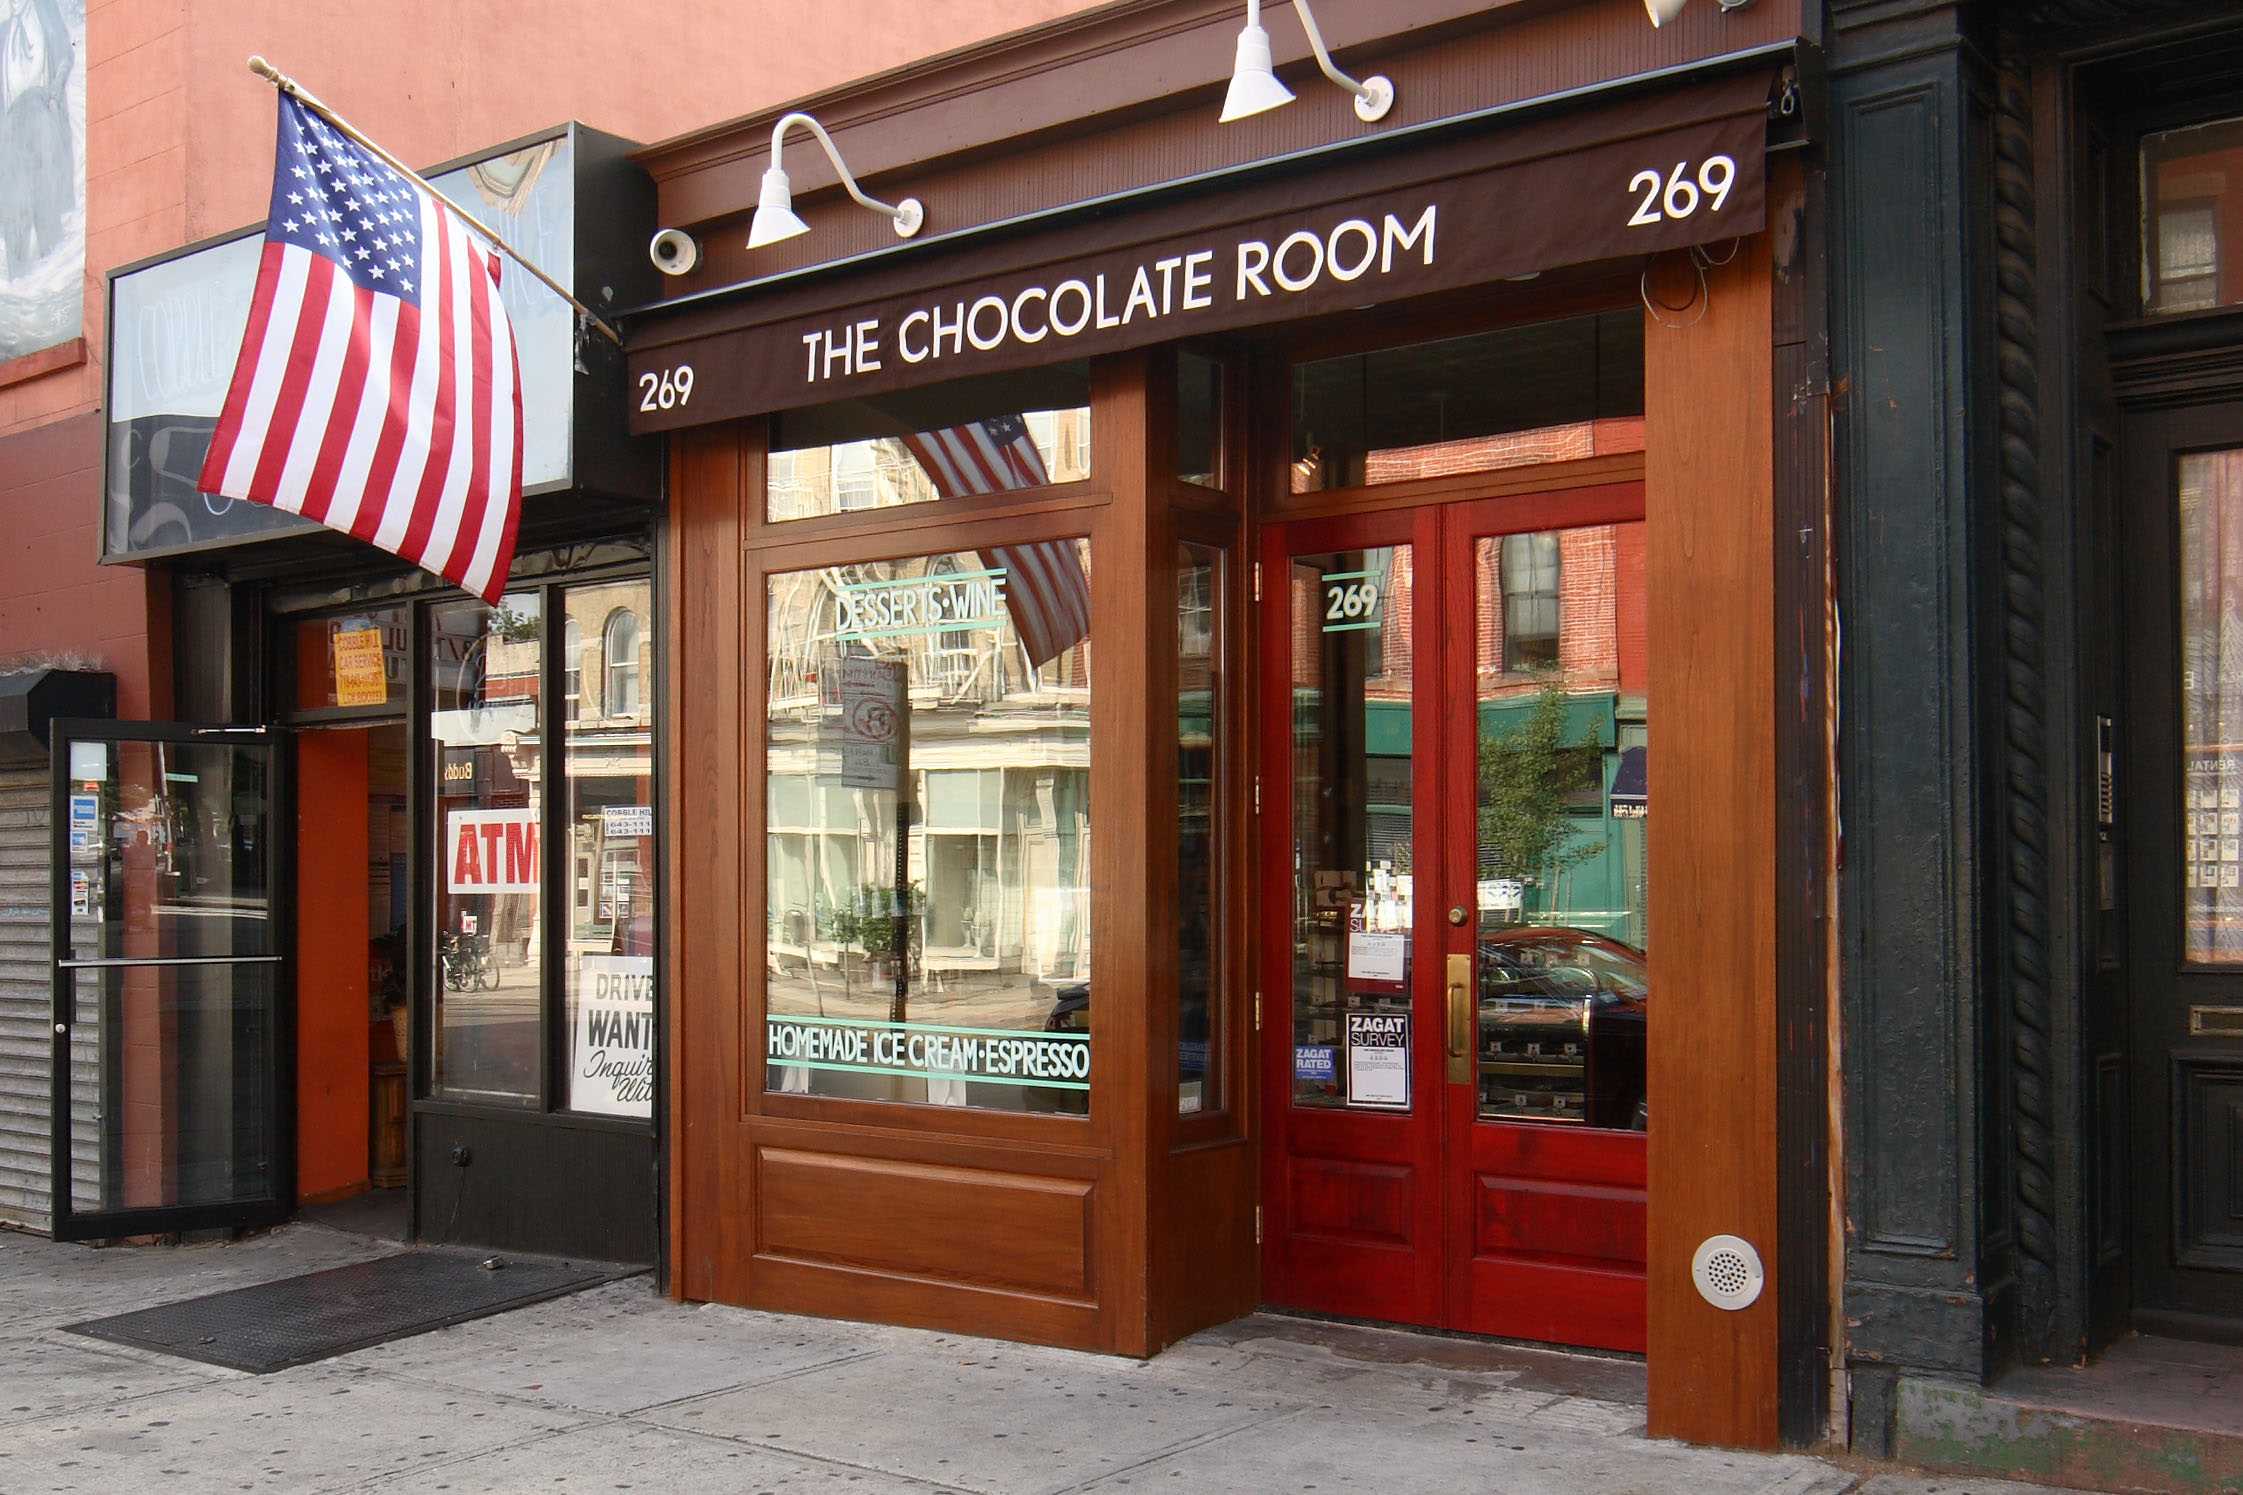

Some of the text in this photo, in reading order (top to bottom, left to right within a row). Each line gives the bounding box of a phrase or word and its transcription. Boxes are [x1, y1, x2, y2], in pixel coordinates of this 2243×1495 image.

[1626, 155, 1736, 227] 269
[802, 204, 1438, 383] THE CHOCOLATE ROOM
[638, 365, 695, 413] 269
[1326, 583, 1378, 620] 269
[453, 822, 541, 884] ATM
[1350, 1017, 1405, 1033] ZAGAT
[1350, 1032, 1405, 1047] SURVEY
[768, 1023, 1090, 1079] HOMEMADE ICE CREAM ESPRESSO
[1295, 1048, 1332, 1059] ZAGAT
[1295, 1059, 1332, 1070] RATED
